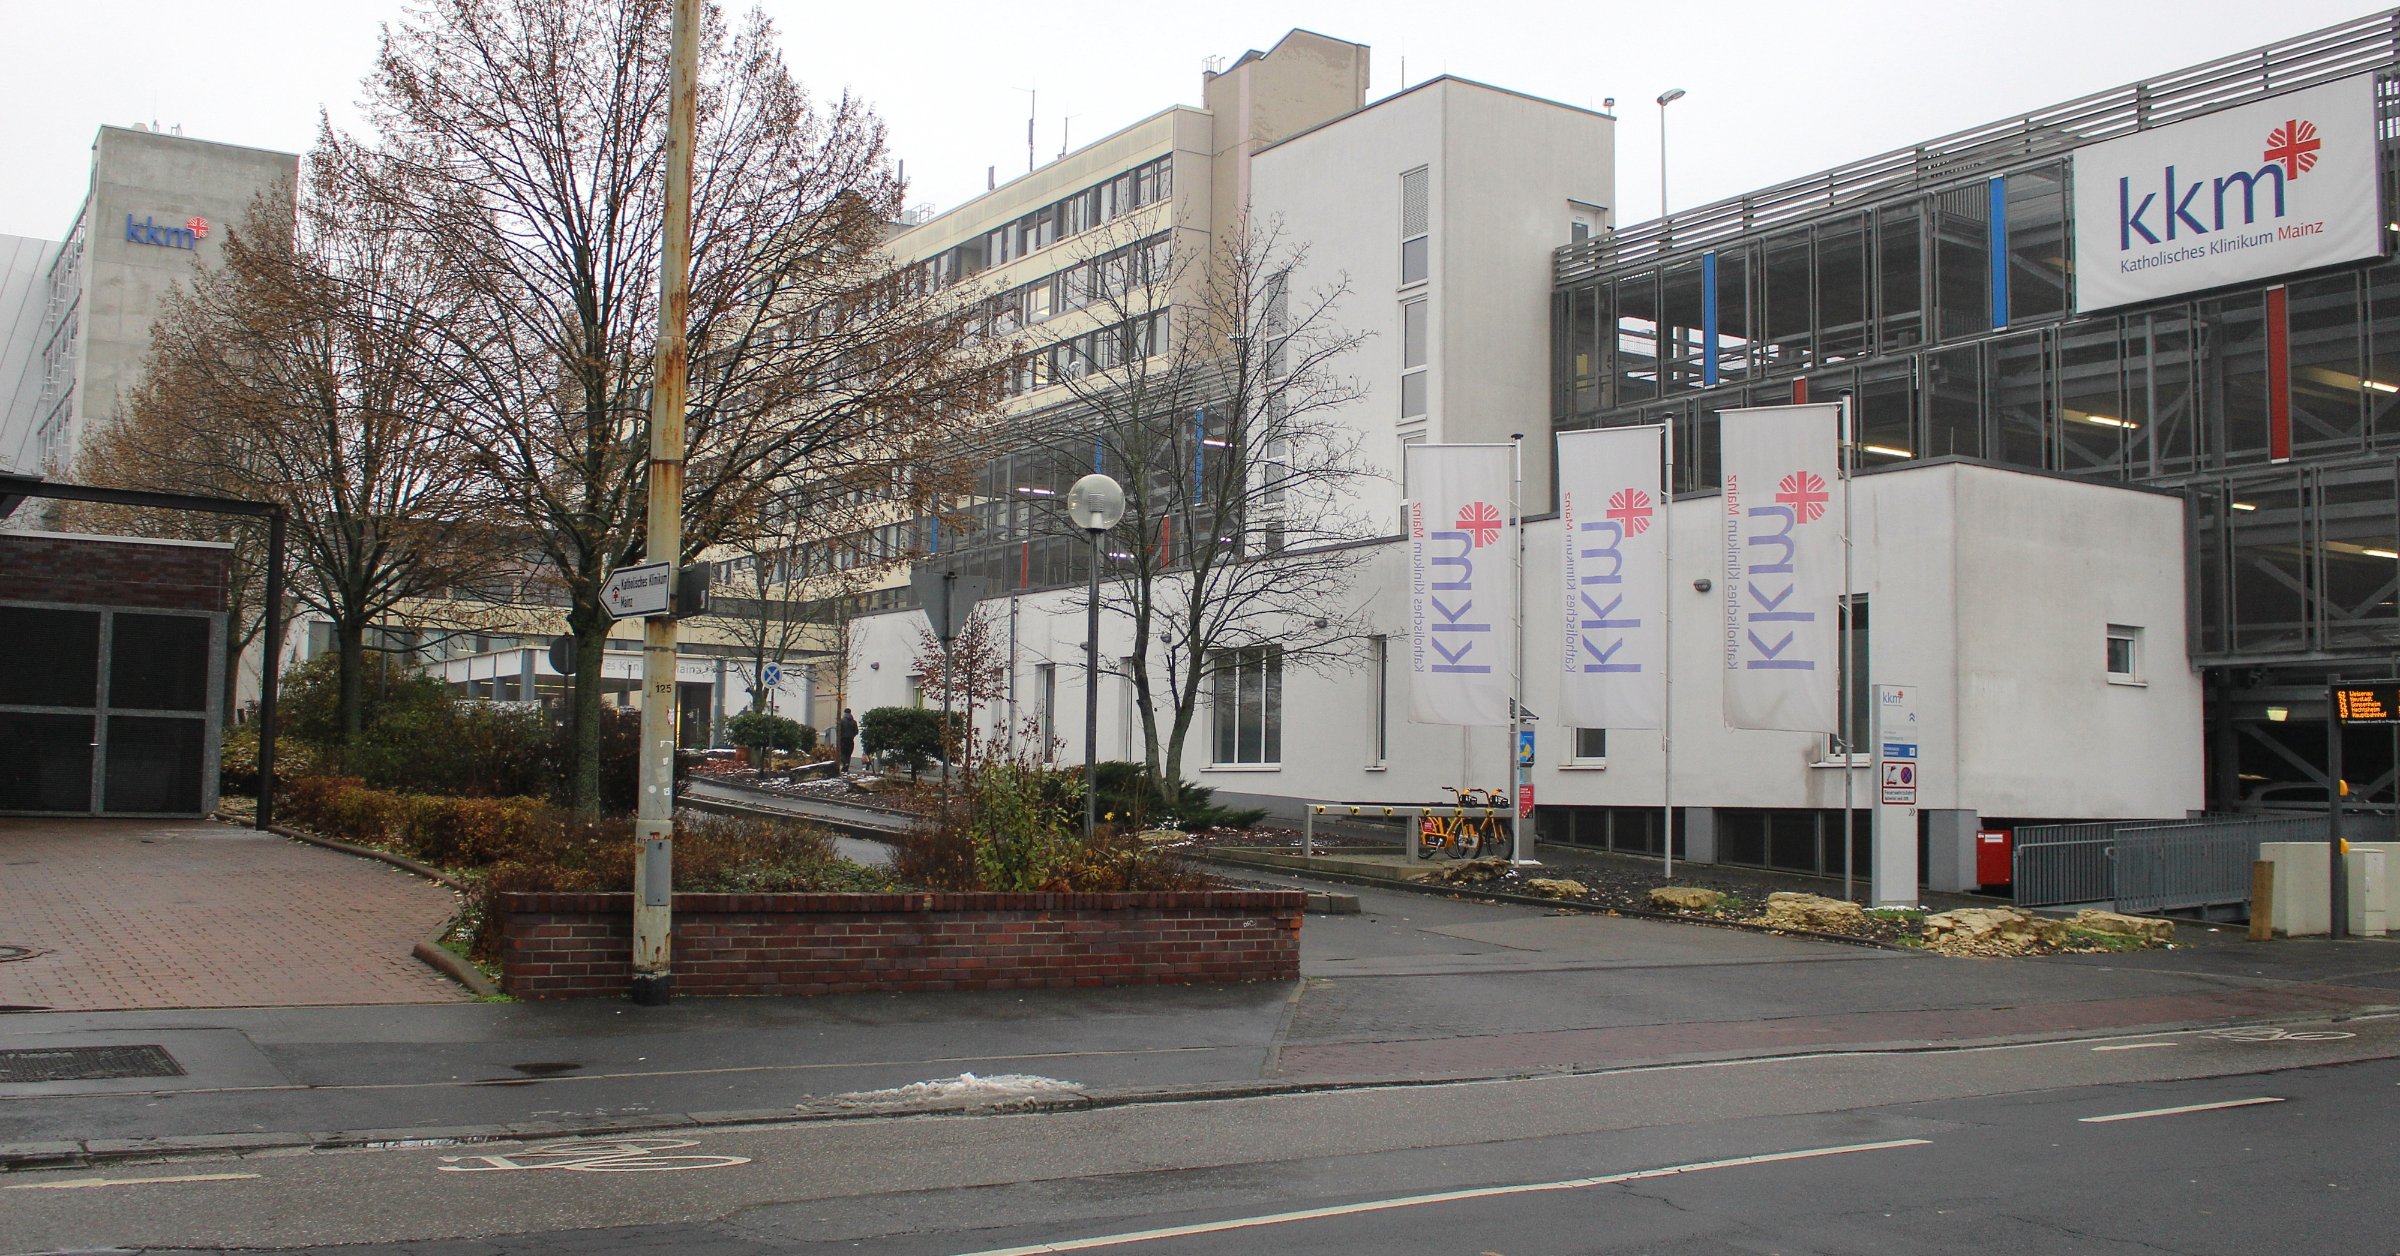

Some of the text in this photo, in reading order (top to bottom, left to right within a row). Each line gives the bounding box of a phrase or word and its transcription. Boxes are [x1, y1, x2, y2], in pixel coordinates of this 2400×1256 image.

[2119, 163, 2286, 251] kkm
[127, 213, 196, 250] kkm
[2120, 221, 2324, 274] Katholisches Klinikum Mainz
[621, 572, 668, 591] Katholisches Klinikum
[621, 596, 633, 608] Mainz
[655, 684, 672, 693] 125
[1882, 690, 1901, 704] kkm
